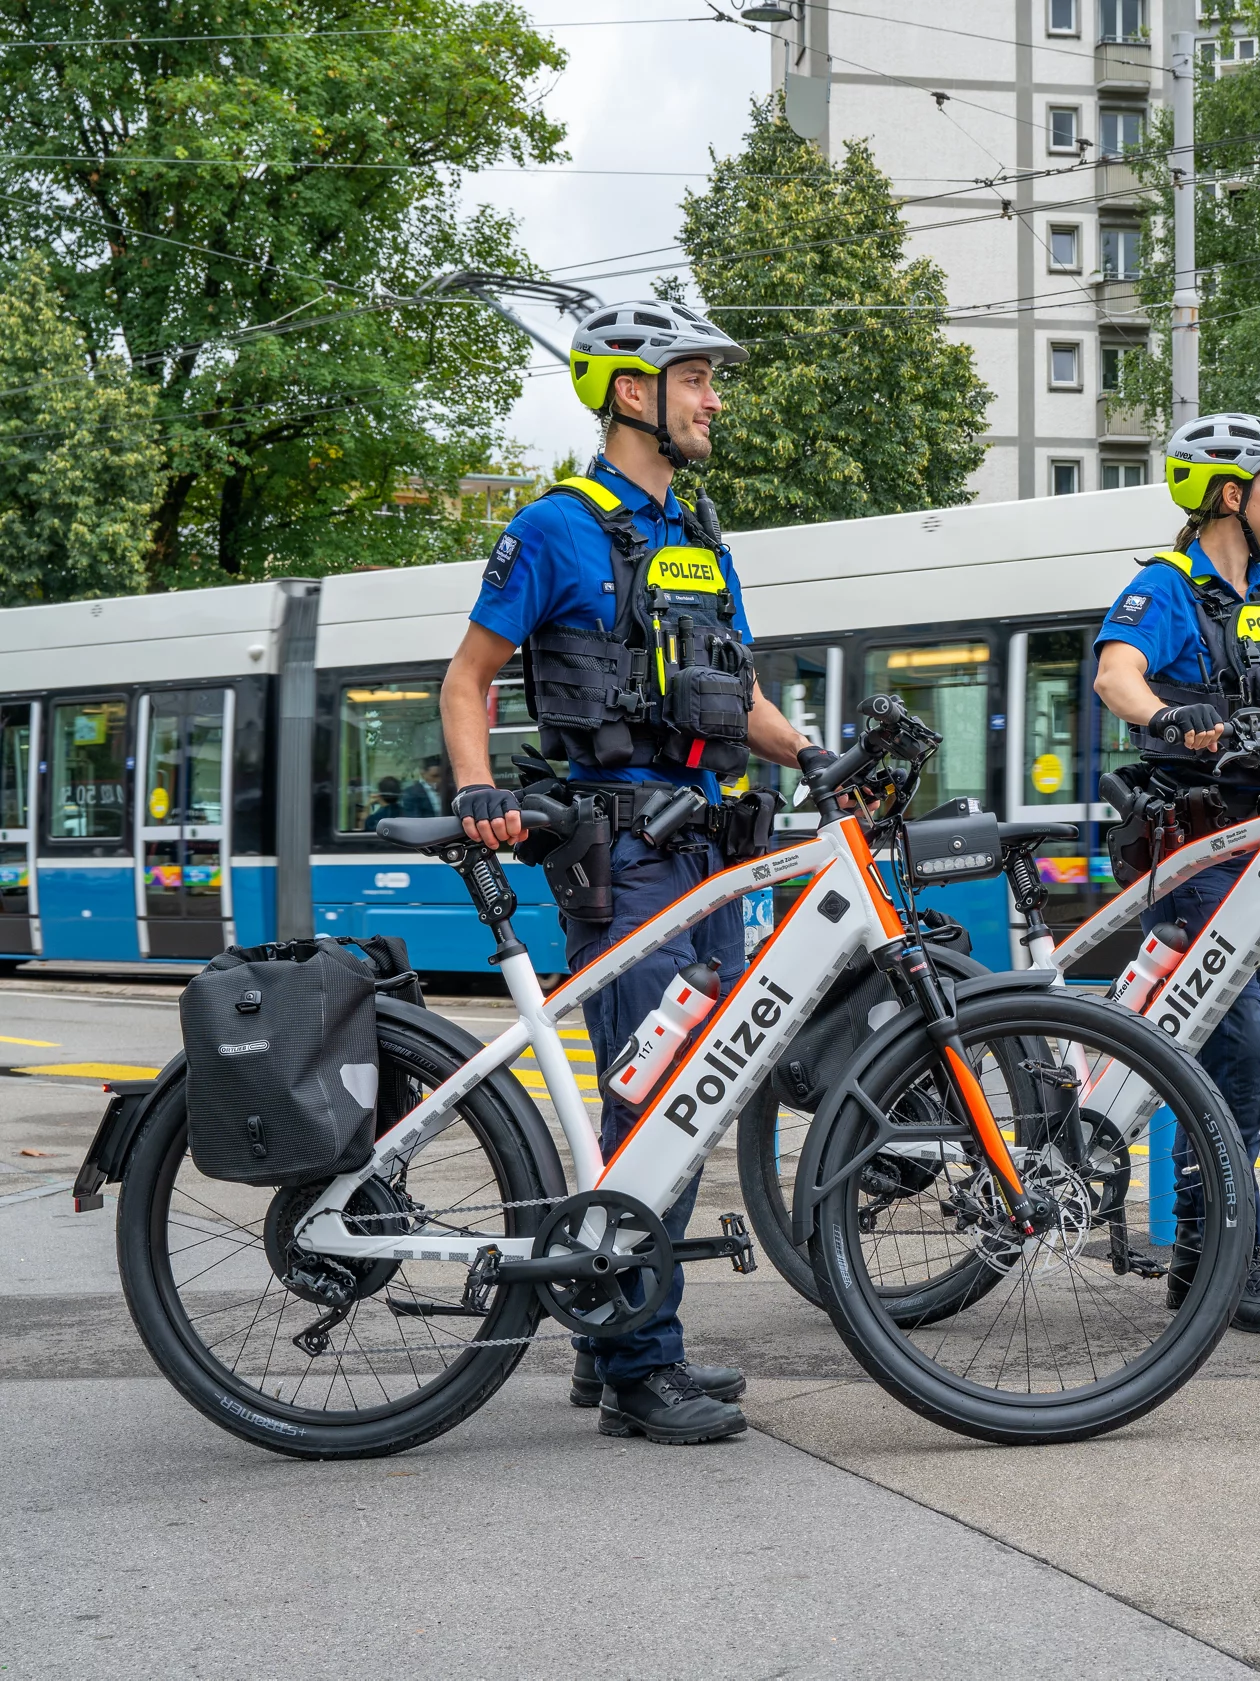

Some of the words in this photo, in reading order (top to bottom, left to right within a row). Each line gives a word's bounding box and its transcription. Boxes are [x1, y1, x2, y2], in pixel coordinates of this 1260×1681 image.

[575, 341, 593, 353] uvex
[1174, 450, 1194, 460] uvex
[659, 561, 714, 580] POLIZEI
[774, 861, 799, 872] Stadtpolizei
[784, 854, 799, 863] Zürich
[1112, 979, 1131, 1003] lizei
[1158, 929, 1236, 1038] olizei
[638, 1040, 654, 1060] 117
[663, 975, 794, 1138] Polizei
